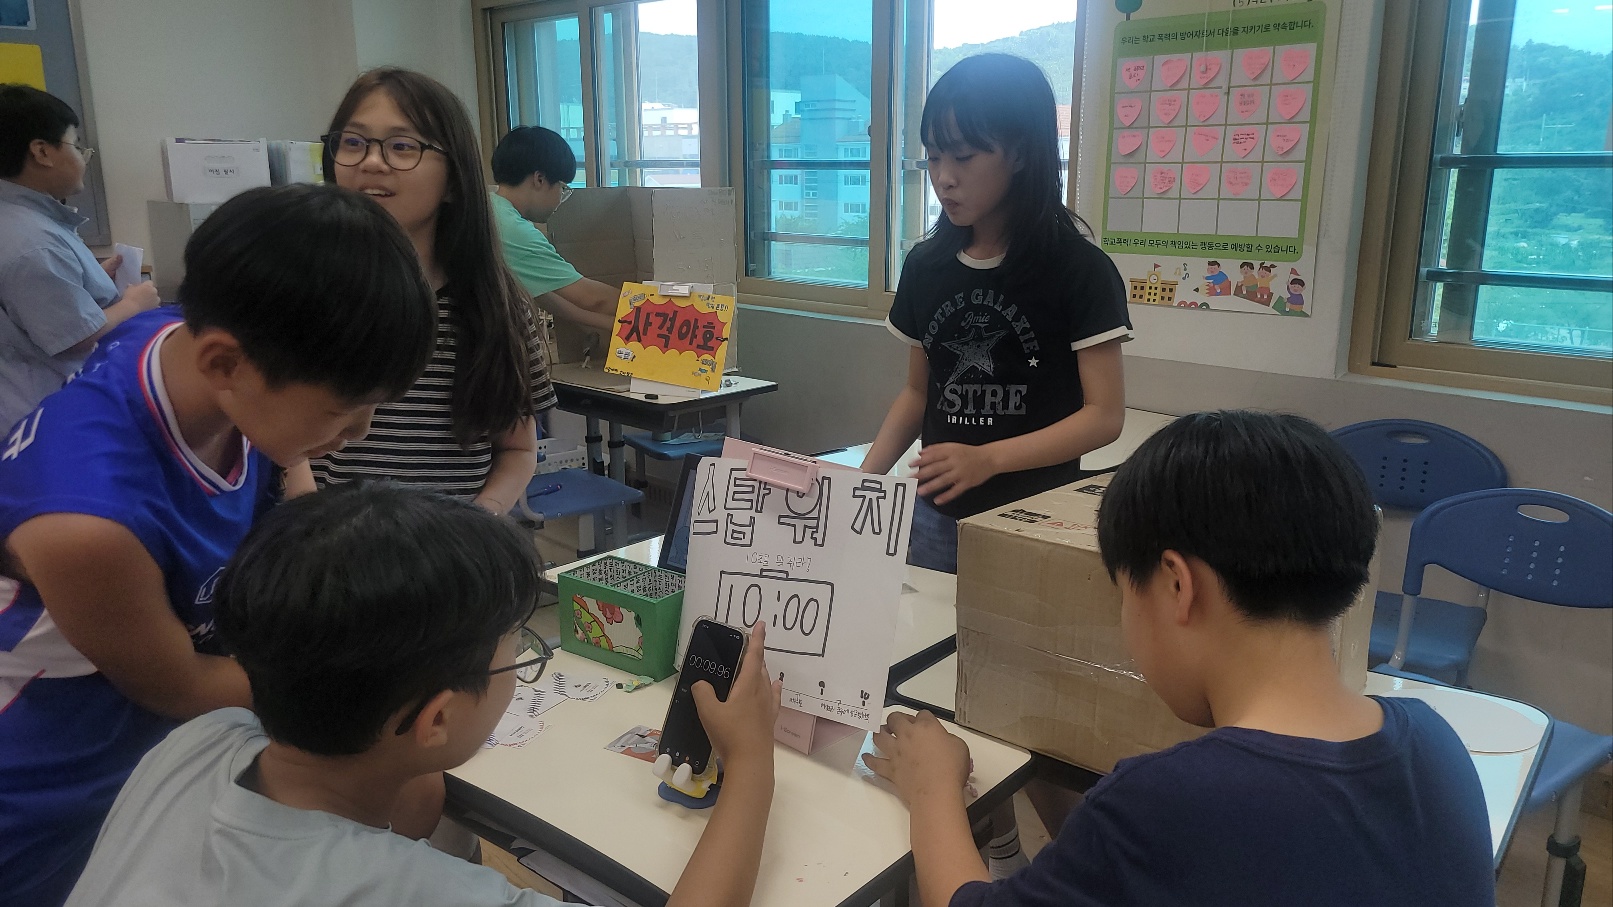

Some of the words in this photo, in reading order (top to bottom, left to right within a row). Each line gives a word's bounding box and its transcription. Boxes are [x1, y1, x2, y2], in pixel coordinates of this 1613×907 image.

[1121, 36, 1140, 45] 우리는
[1142, 34, 1155, 43] 학교
[1157, 32, 1178, 42] 폭력의
[1179, 28, 1215, 41] 방어자로서
[1217, 26, 1239, 37] 다음을
[1241, 23, 1271, 34] 지키기로
[1272, 19, 1314, 32] 약속합니다.
[1132, 238, 1147, 248] 우리
[1148, 239, 1169, 249] 모두의
[1170, 240, 1199, 250] 책임있는
[1200, 241, 1229, 251] 행동으로
[1230, 242, 1253, 253] 예방할
[1255, 243, 1264, 253] 수
[1265, 244, 1299, 255] 있습니다.
[923, 292, 965, 349] NOTRE
[970, 288, 1040, 354] GALAXIE
[725, 583, 820, 637] 10:00
[689, 654, 731, 679] 00:09.96
